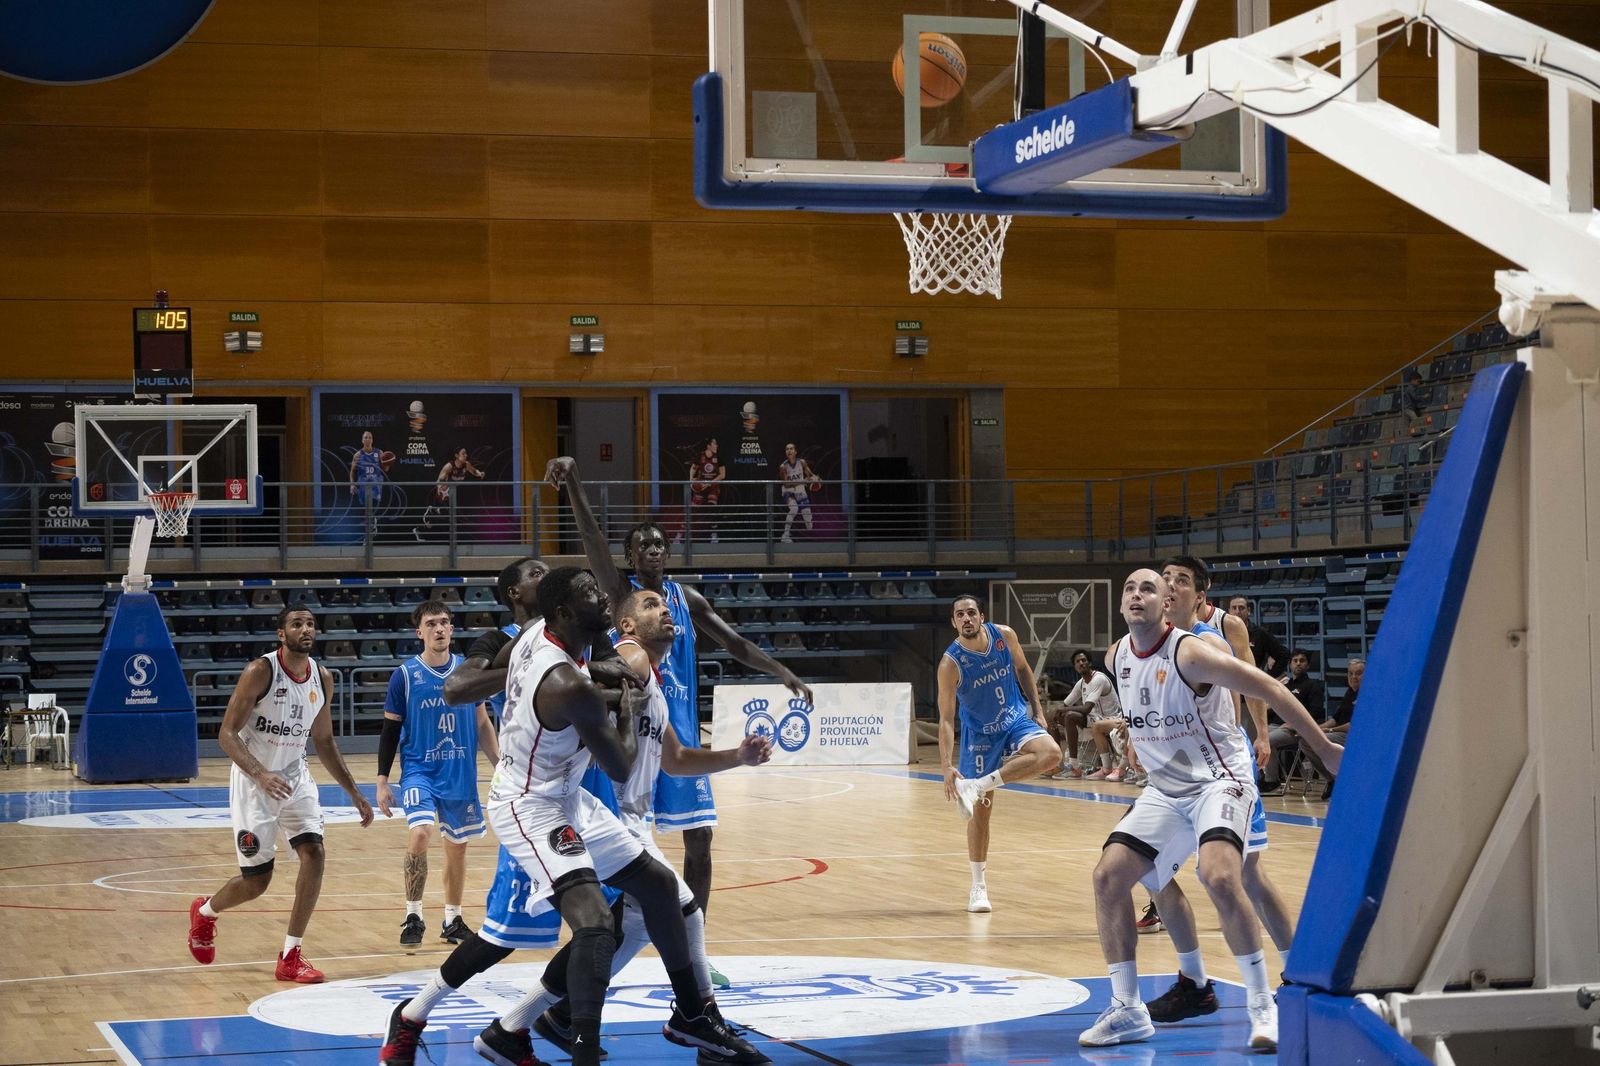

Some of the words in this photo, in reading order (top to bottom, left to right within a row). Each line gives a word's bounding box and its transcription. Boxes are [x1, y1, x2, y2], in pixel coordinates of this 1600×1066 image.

[1015, 114, 1076, 164] schelde
[155, 311, 187, 329] 1:05
[231, 313, 256, 321] SALIDA
[572, 317, 597, 325] SALIDA
[897, 321, 920, 330] SALIDA
[136, 377, 190, 386] HUELVA
[0, 400, 22, 409] desa
[49, 491, 72, 500] ende
[53, 518, 90, 528] REINA
[131, 688, 152, 698] Schelde
[664, 685, 689, 701] RITA
[994, 686, 1005, 706] 9
[1139, 687, 1151, 706] 8
[125, 696, 158, 705] International
[420, 697, 446, 709] AVA
[289, 704, 304, 720] 31
[437, 712, 455, 734] 40
[820, 714, 884, 725] DIPUTACIÓN
[1124, 709, 1194, 730] eleGroup
[820, 727, 882, 736] PROVINCIAL
[830, 737, 869, 746] HUELVA
[975, 755, 984, 774] 9
[403, 787, 420, 808] 40
[1220, 803, 1235, 822] 8
